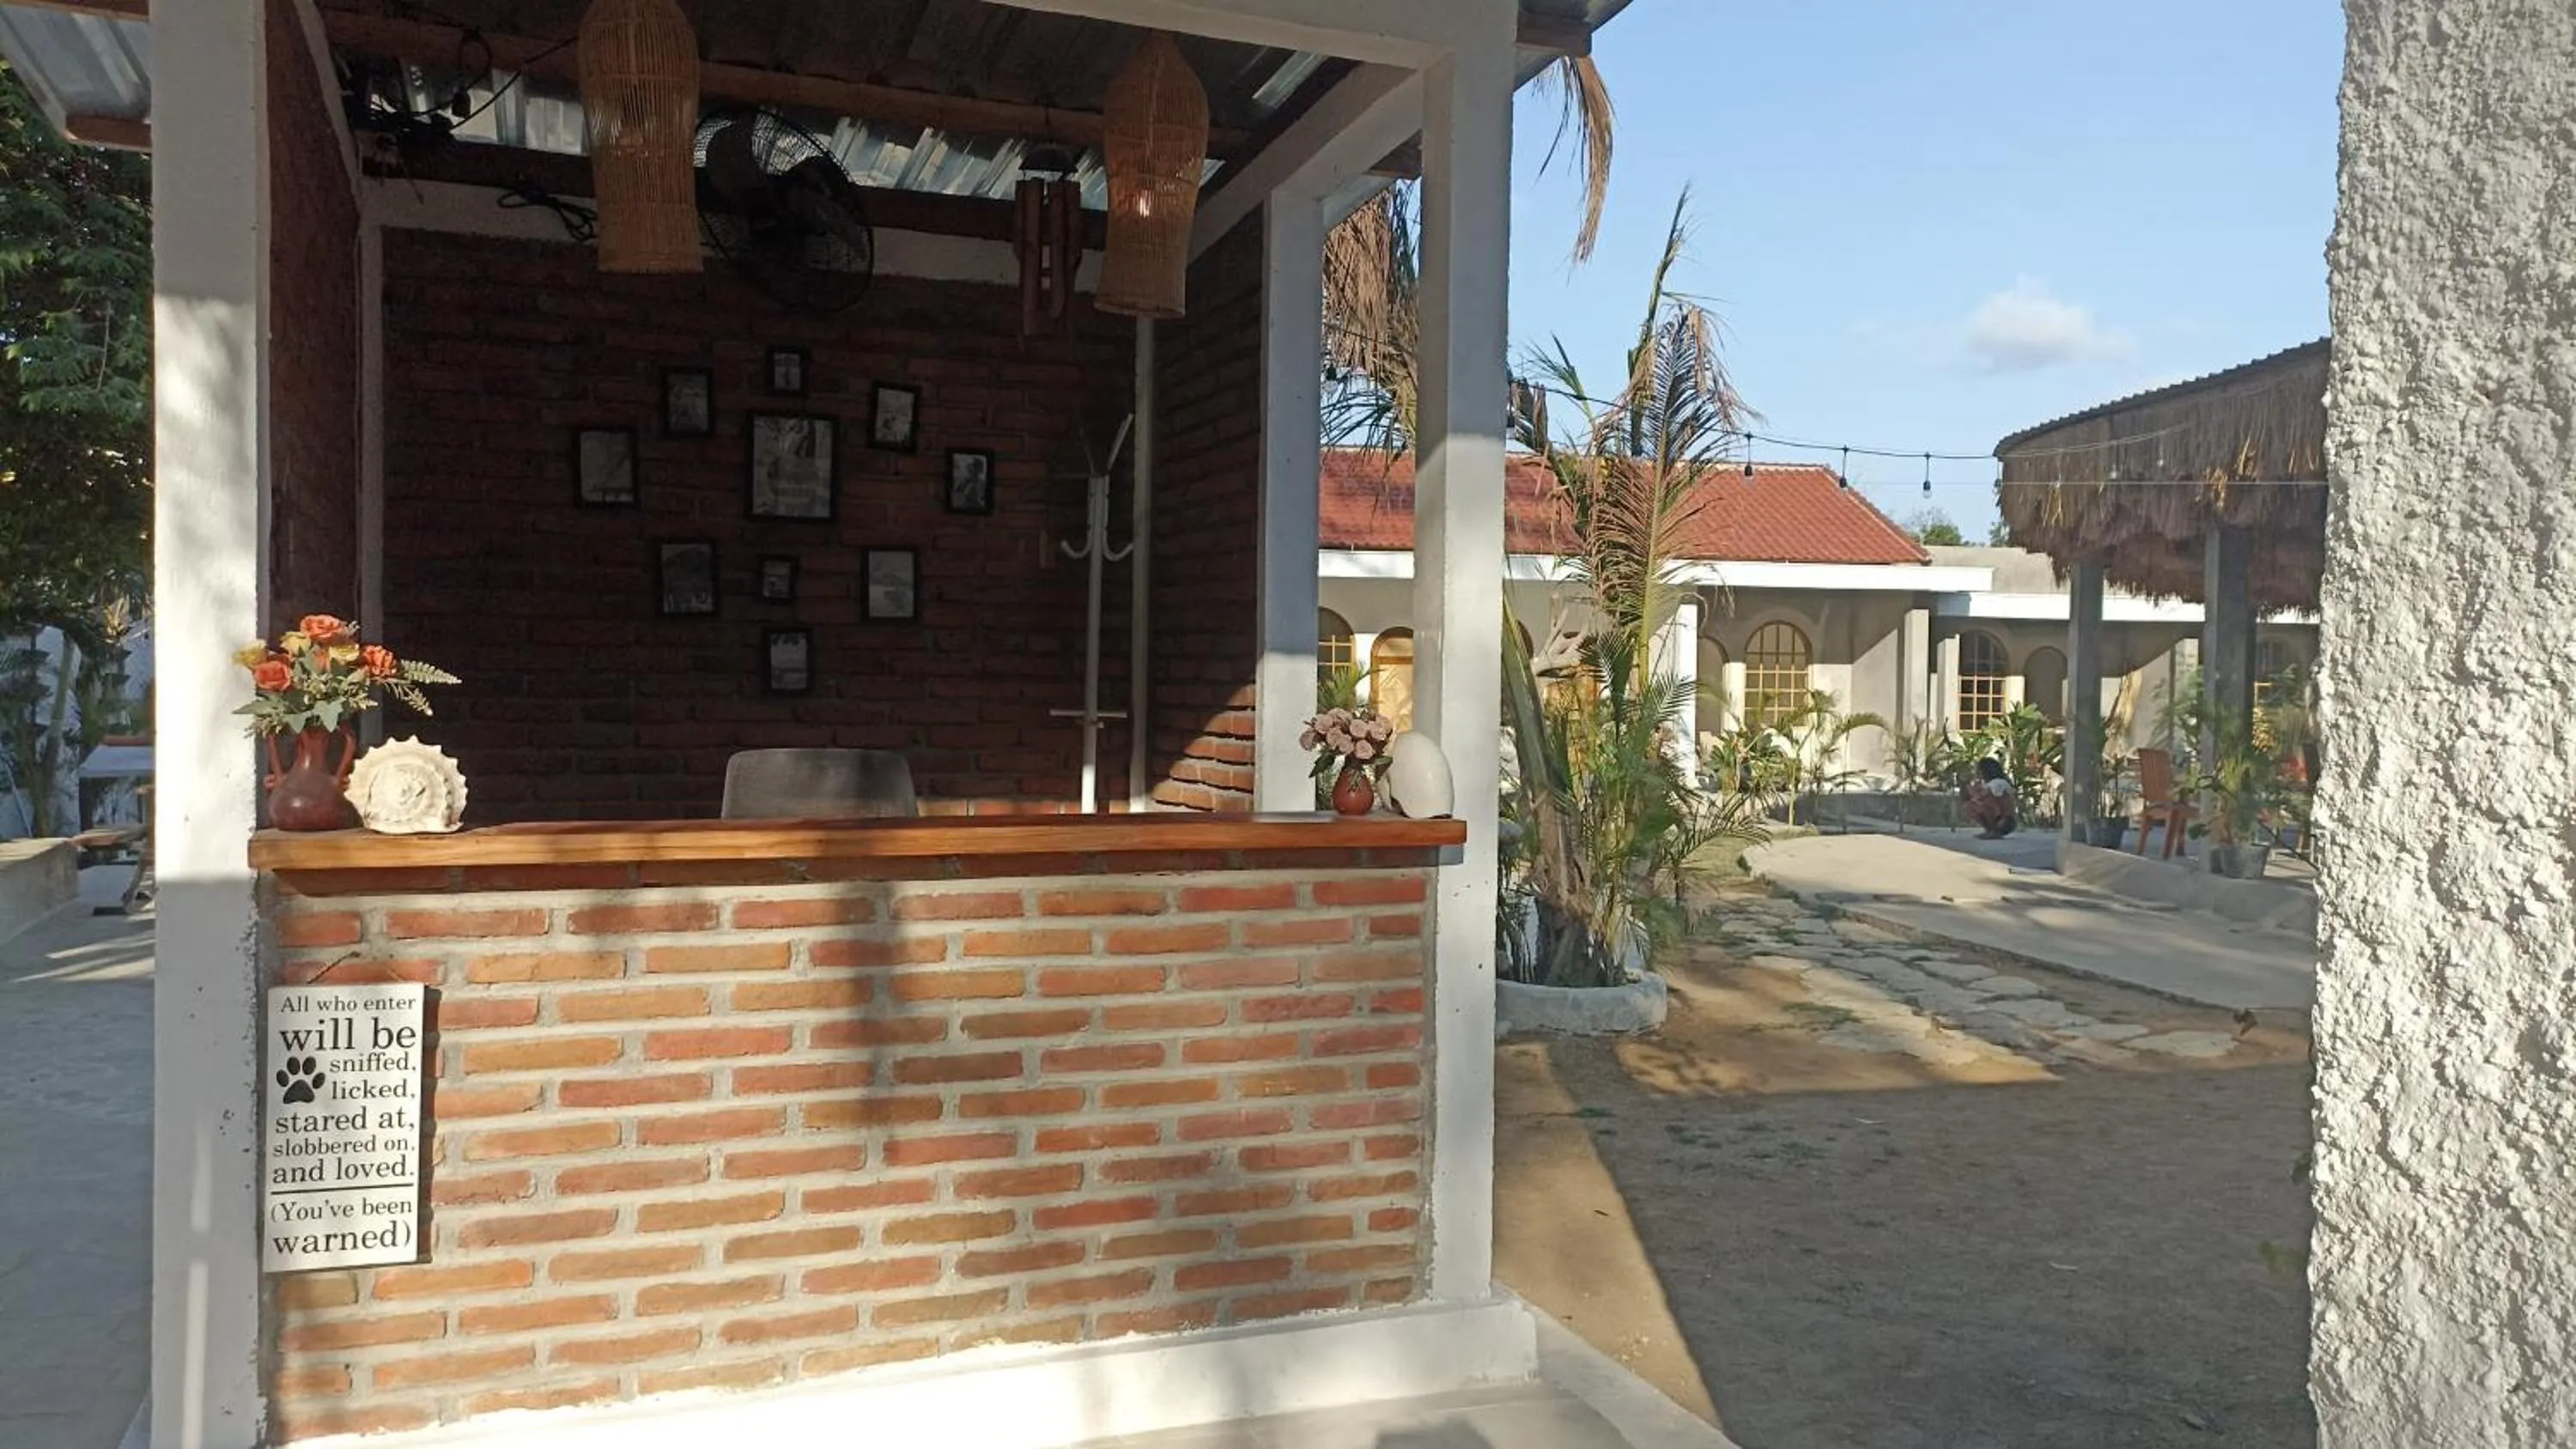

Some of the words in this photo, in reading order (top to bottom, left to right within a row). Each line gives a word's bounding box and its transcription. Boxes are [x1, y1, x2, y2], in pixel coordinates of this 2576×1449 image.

[280, 996, 309, 1013] All
[317, 996, 357, 1010] who
[363, 997, 416, 1010] enter
[280, 1017, 355, 1052] will
[372, 1016, 416, 1049] be
[331, 1079, 416, 1100] licked,
[275, 1105, 368, 1134] stared
[378, 1108, 416, 1131] at,
[273, 1135, 376, 1157] slobbered
[272, 1159, 324, 1185] and
[335, 1154, 416, 1181] loved.
[362, 1198, 412, 1216] been
[273, 1220, 412, 1255] warned)
